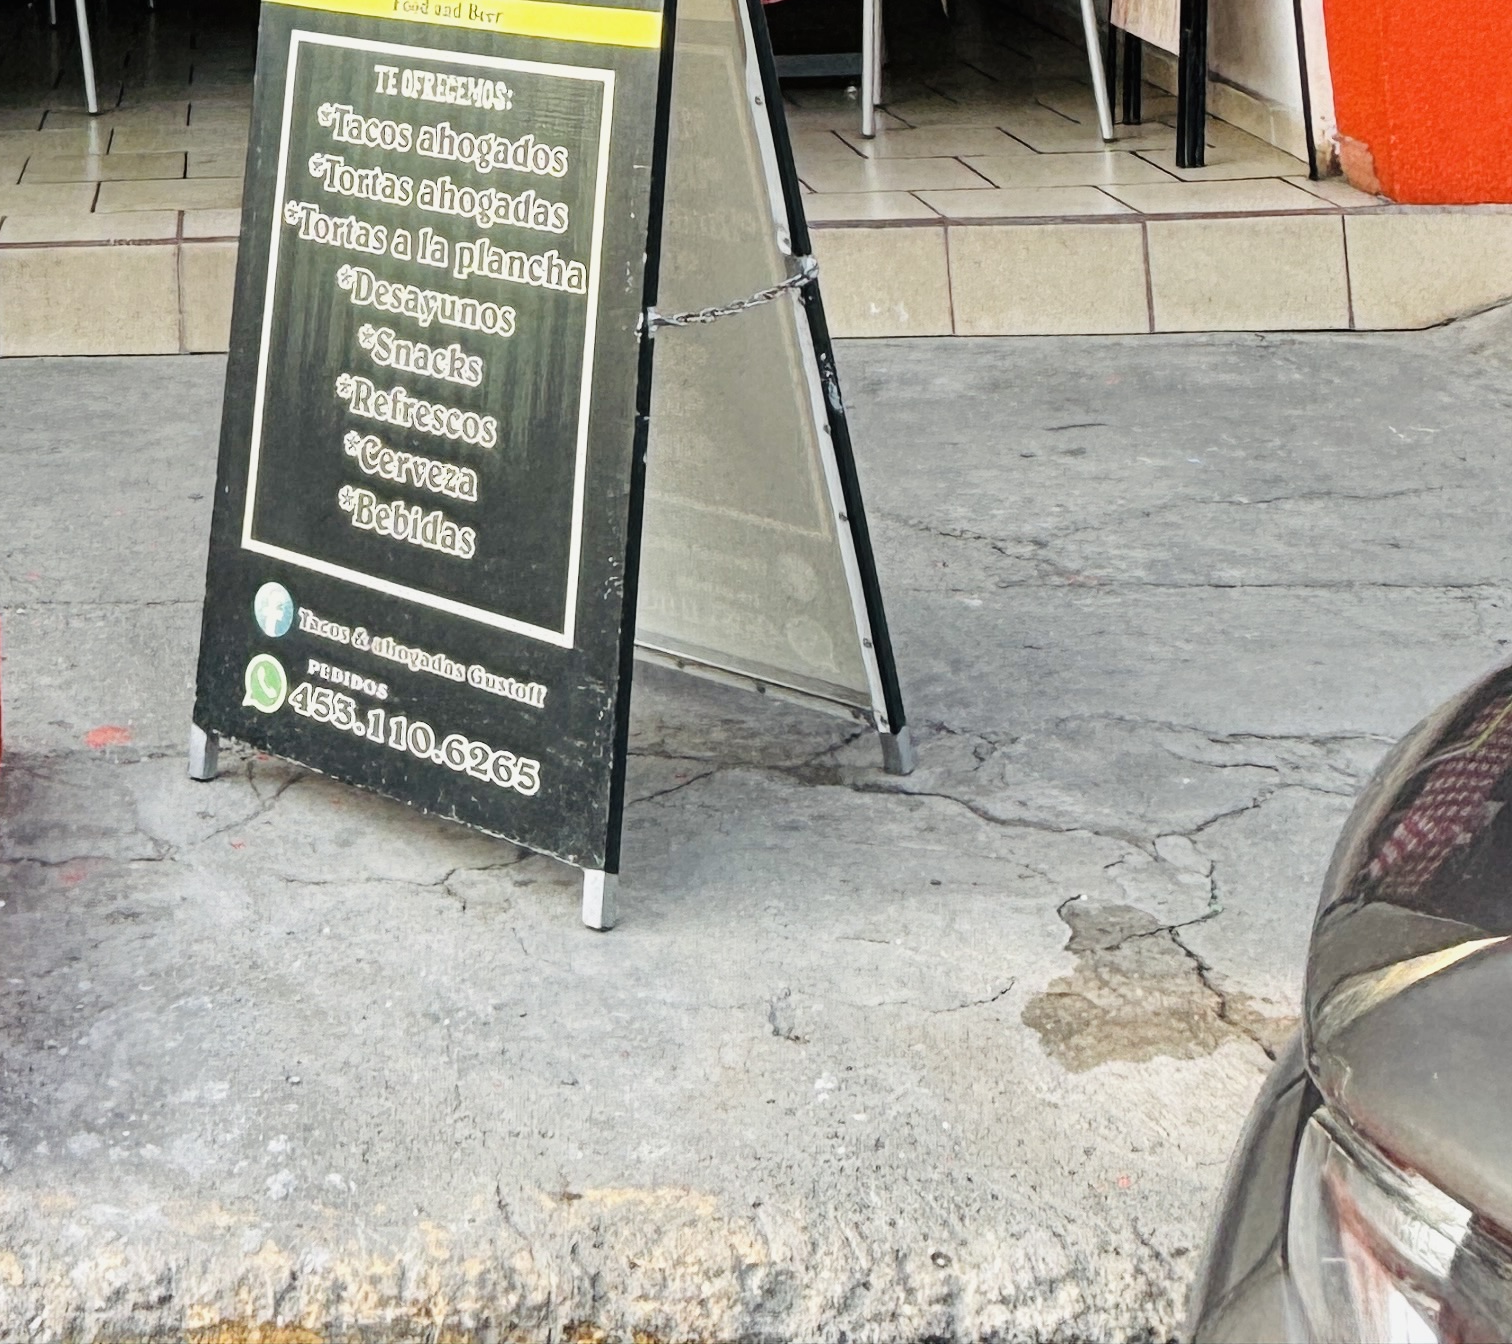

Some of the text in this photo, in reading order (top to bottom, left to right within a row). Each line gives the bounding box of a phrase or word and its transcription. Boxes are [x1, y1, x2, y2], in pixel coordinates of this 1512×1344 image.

[374, 64, 399, 96] TE
[416, 122, 569, 178] ahogados
[417, 175, 569, 234] ahogadas
[391, 228, 411, 260] a
[417, 227, 448, 268] la
[454, 237, 587, 295] plancha
[298, 607, 350, 644] Tacos
[351, 627, 371, 651] &
[308, 659, 388, 700] PEDIDOS
[289, 681, 541, 797] 453.110.6265
